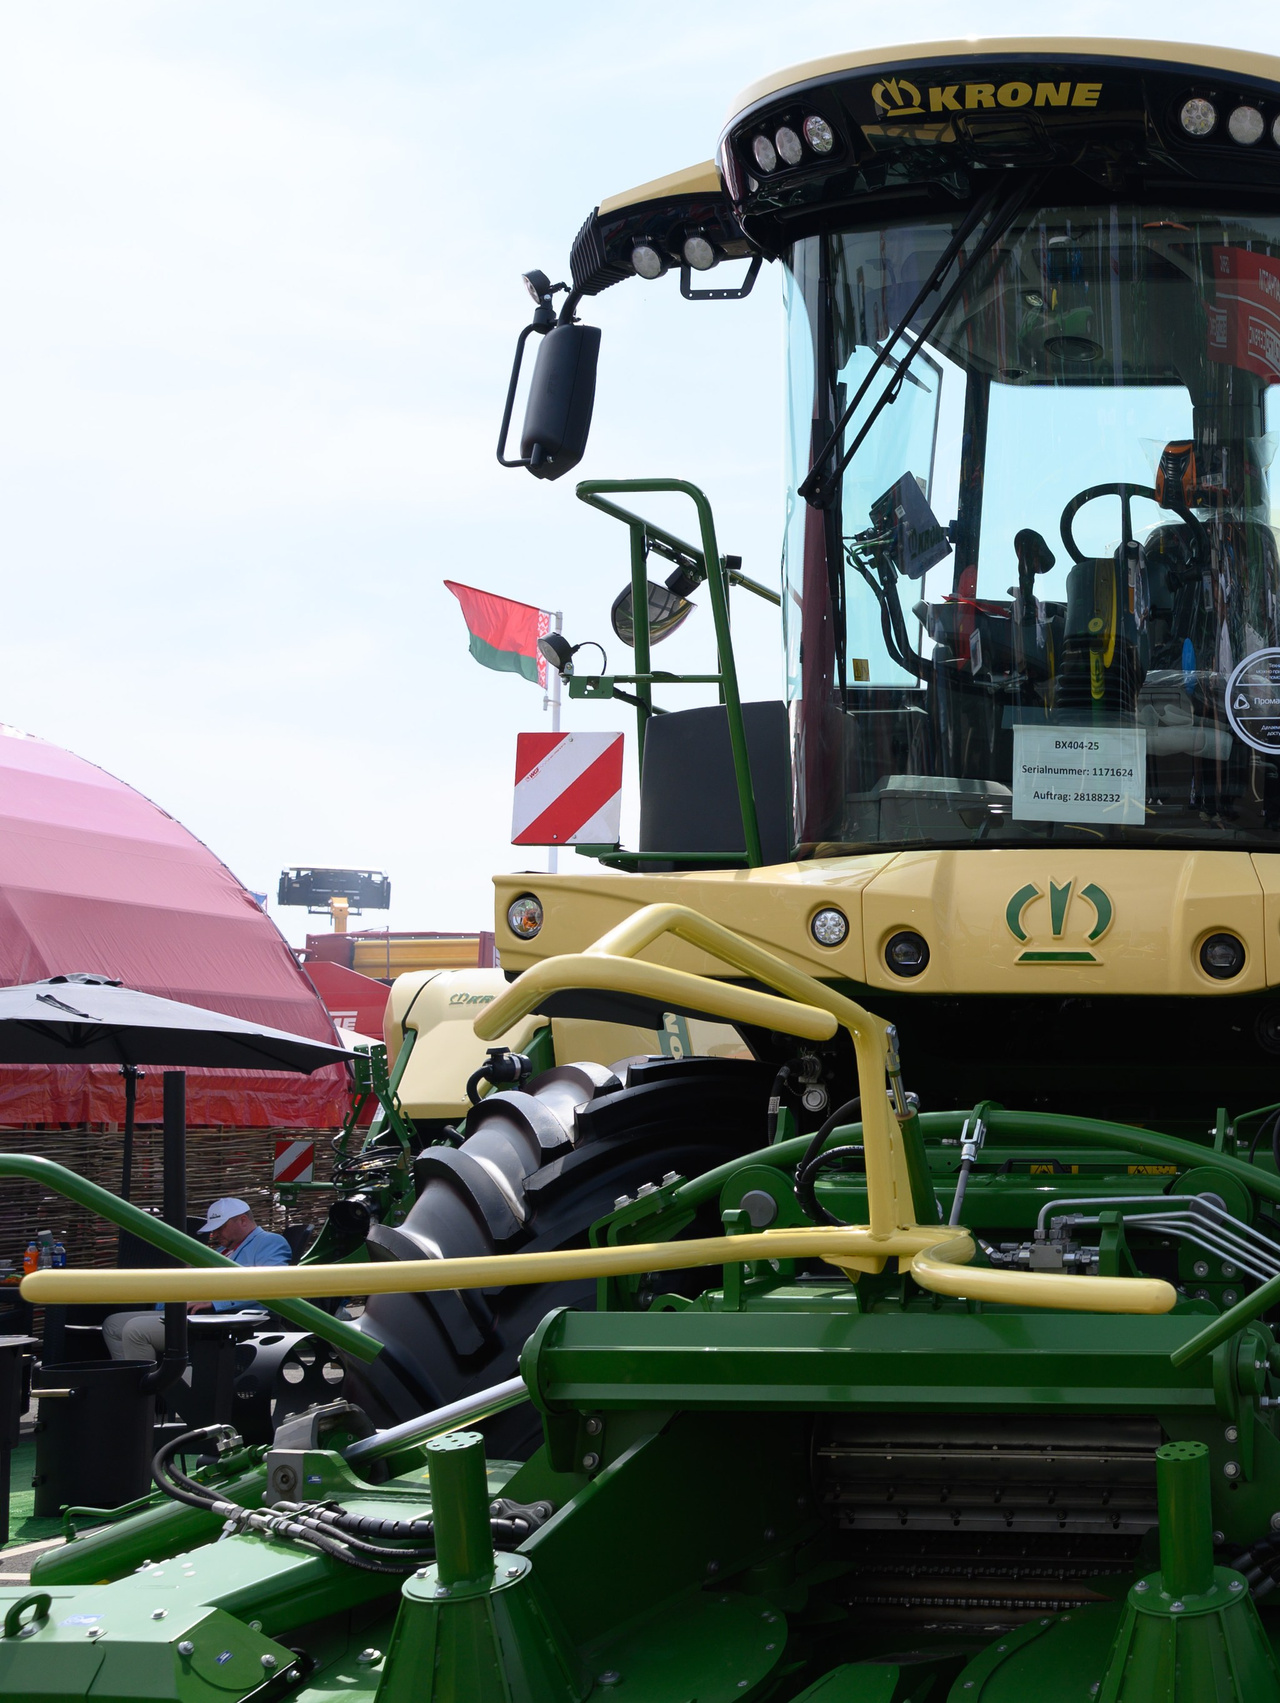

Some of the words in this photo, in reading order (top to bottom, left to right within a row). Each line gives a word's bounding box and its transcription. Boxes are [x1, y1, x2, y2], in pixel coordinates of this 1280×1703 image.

[928, 81, 1103, 112] KRONE
[1054, 740, 1100, 751] BX404-25
[1022, 764, 1090, 776] Serialnummer:
[1092, 767, 1133, 777] 1171624
[1033, 791, 1071, 802] Auftrag:
[1073, 792, 1121, 803] 28188232
[466, 995, 497, 1005] KR
